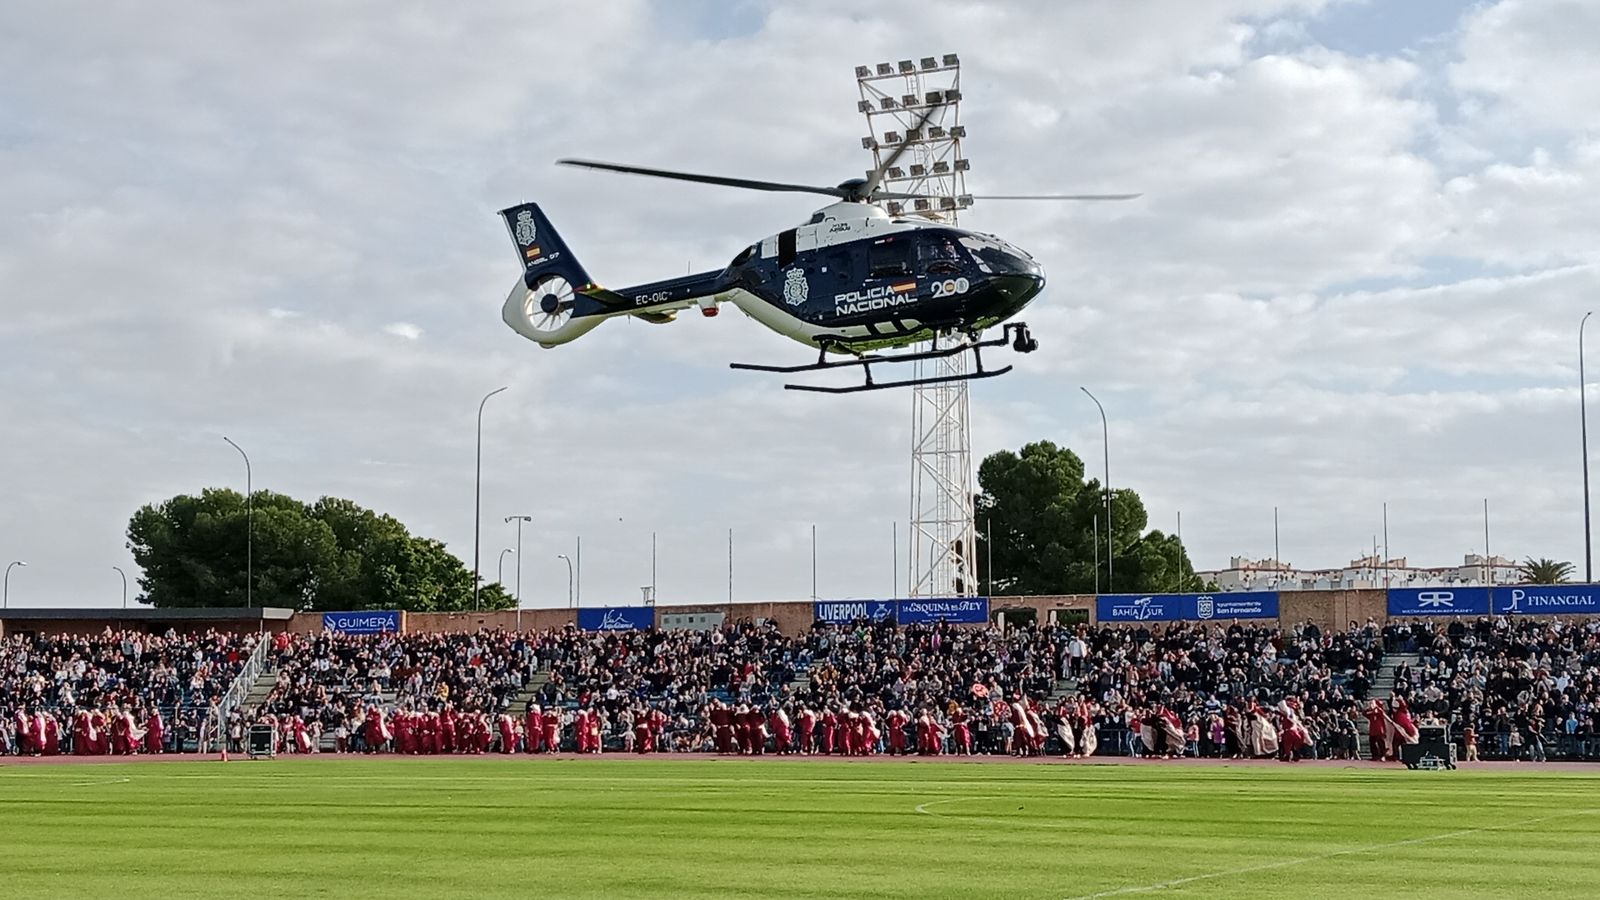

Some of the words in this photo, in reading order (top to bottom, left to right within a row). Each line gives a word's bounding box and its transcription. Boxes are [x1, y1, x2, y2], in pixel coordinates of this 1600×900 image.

[834, 285, 895, 305] POLICIA
[930, 277, 970, 299] 200
[835, 292, 918, 316] NACIONAL
[909, 602, 950, 614] ESQUINA
[959, 601, 982, 611] REY
[1528, 595, 1595, 606] FINANCIAL
[819, 602, 870, 620] LIVERPOOL
[1147, 607, 1164, 616] SUR
[338, 614, 395, 628] GUIMERÁ
